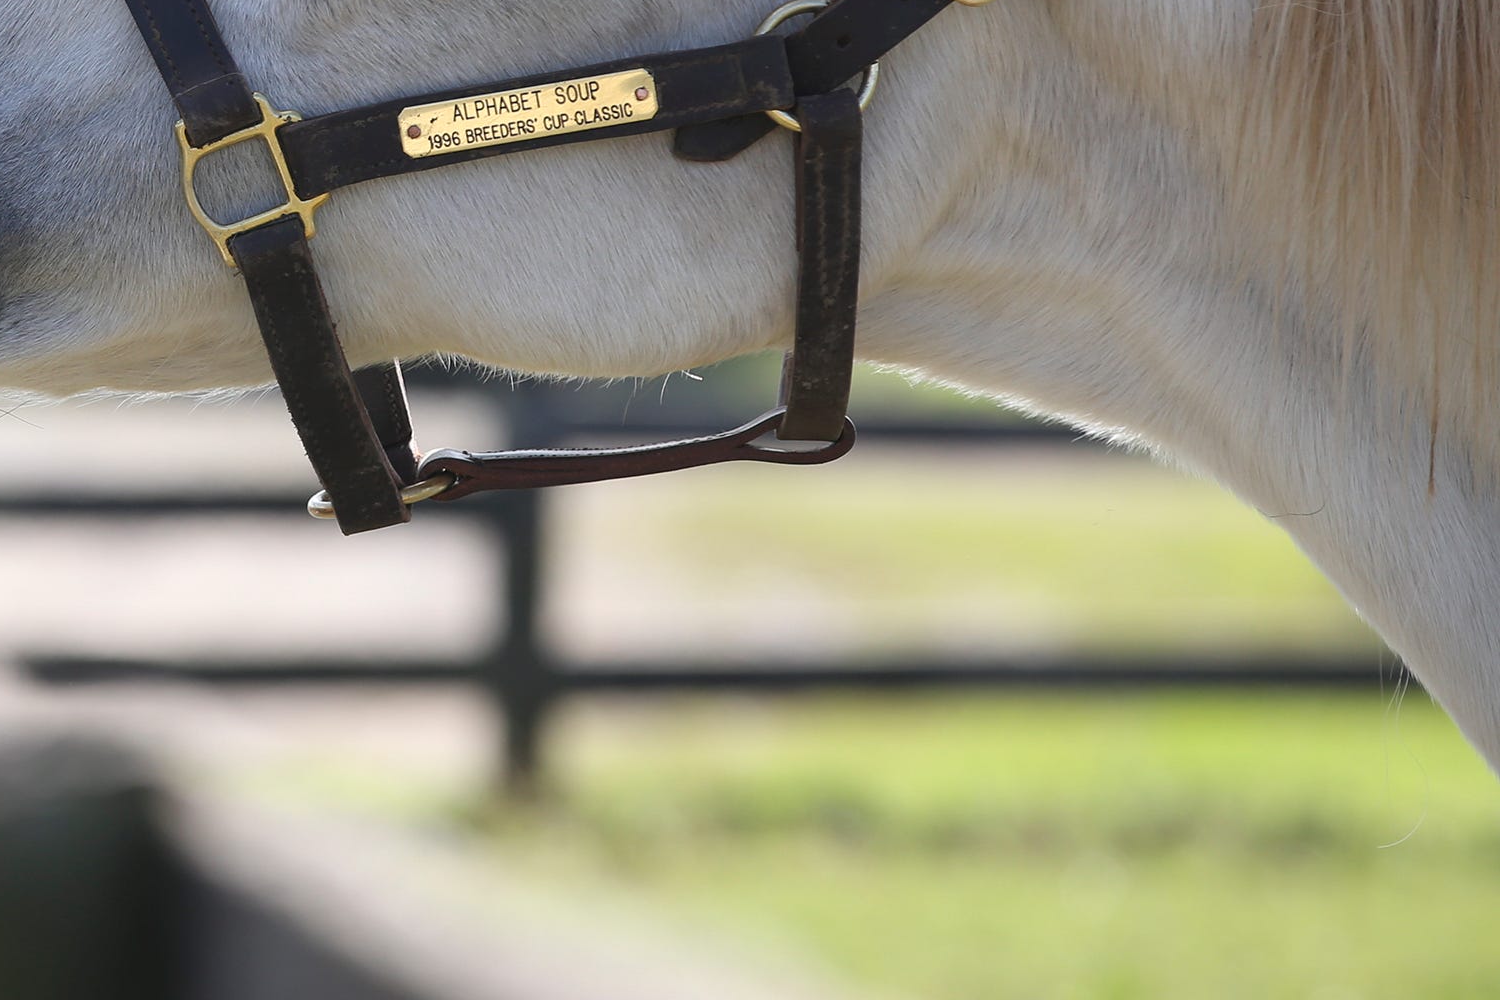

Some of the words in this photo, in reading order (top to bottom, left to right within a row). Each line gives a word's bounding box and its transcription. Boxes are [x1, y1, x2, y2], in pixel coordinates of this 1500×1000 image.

[452, 89, 542, 122] ALPHABET
[555, 80, 600, 104] SOUP
[428, 133, 461, 150] 1996
[466, 117, 538, 144] BREEDERS'
[543, 113, 569, 131] CUP
[573, 102, 633, 126] CLASSIC
